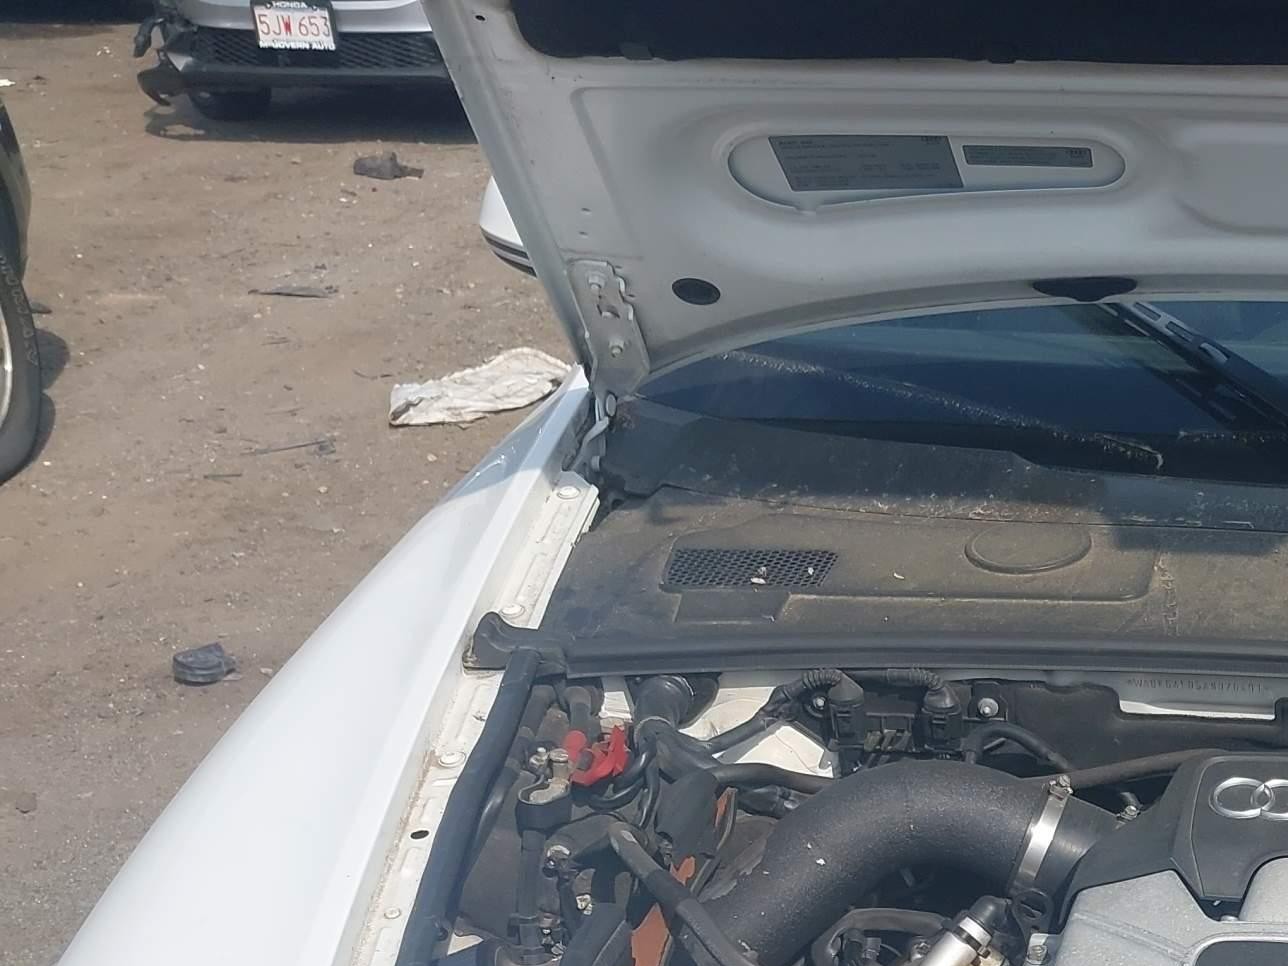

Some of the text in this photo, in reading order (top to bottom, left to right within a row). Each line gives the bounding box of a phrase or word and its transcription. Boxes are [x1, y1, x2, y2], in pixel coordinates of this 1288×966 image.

[272, 1, 308, 9] HONDA
[257, 14, 331, 37] 5JW 653
[311, 42, 337, 51] AUTO
